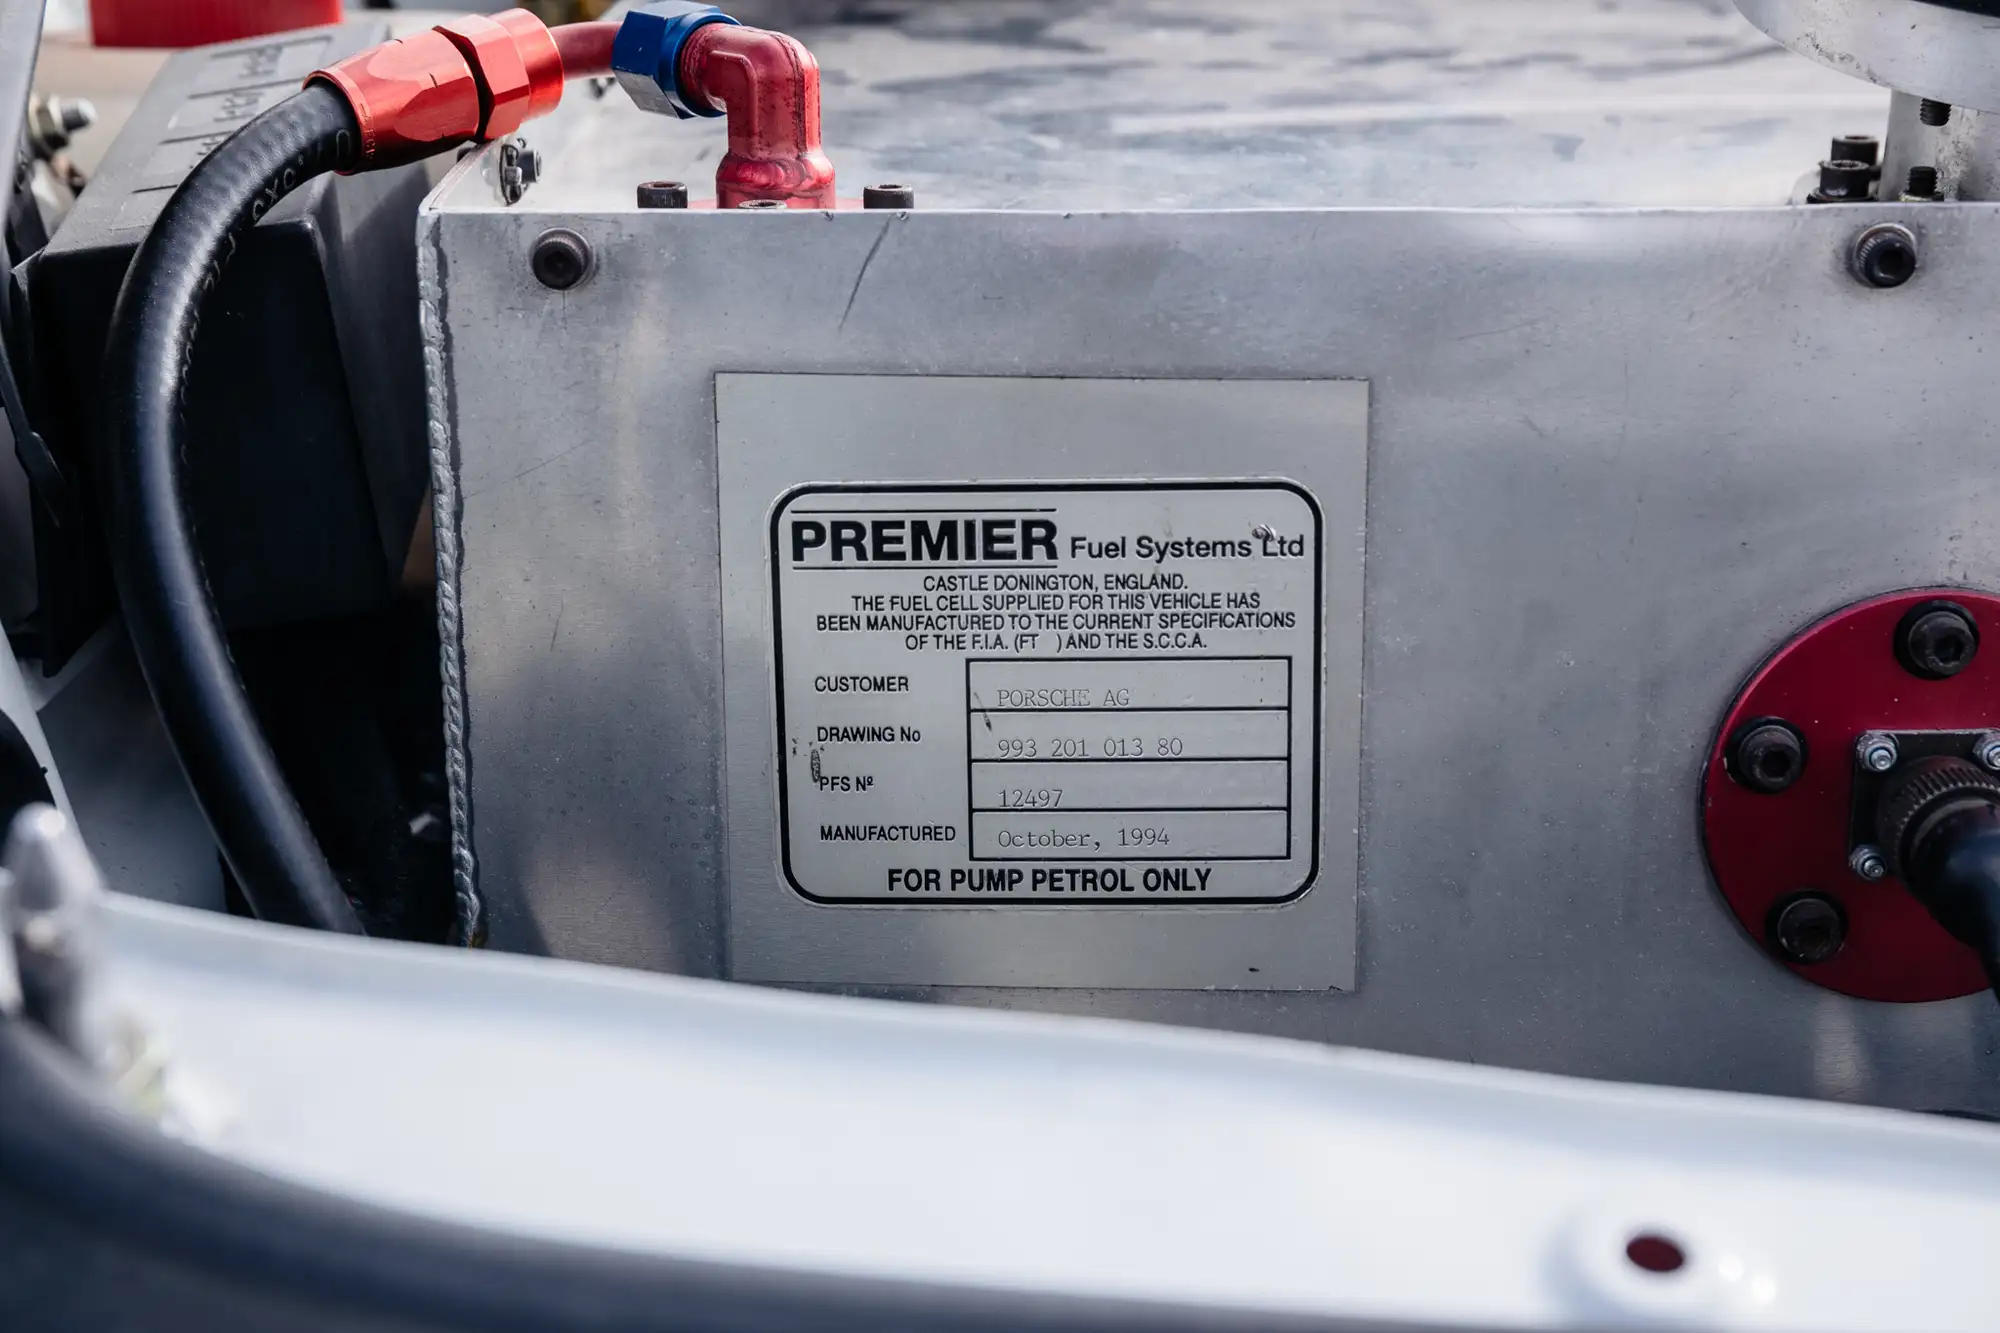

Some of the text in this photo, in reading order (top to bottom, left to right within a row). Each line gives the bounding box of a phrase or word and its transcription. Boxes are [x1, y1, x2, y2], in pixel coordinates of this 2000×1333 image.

[791, 519, 1305, 564] PREMIER Fuel Systems Ltd
[923, 573, 1189, 593] CASTLE DONINGTON, ENGLAND.
[851, 592, 1261, 611] THE FUEL CELL SUPPLIED FOR THIS VEHICLE HAS
[816, 612, 1297, 632] BEEN MANUFACTURED TO THE CURRENT SPECIFICATIONS
[905, 634, 929, 651] OF
[932, 634, 967, 651] THE
[971, 634, 1009, 651] F.I.A.
[1065, 634, 1101, 650] AND
[1105, 633, 1139, 649] THE
[1142, 633, 1208, 650] S.C.C.A.
[814, 675, 910, 693] CUSTOMER
[997, 688, 1130, 708] PORSCHE AG
[816, 726, 922, 743] DRAWING No
[998, 737, 1184, 758] 993 201 013 80
[819, 776, 851, 792] PFS
[999, 789, 1064, 808] 12497
[819, 825, 957, 842] MANUFACTURED
[998, 828, 1170, 852] October, 1994
[887, 868, 1213, 892] FOR PUMP PETROL ONLY
